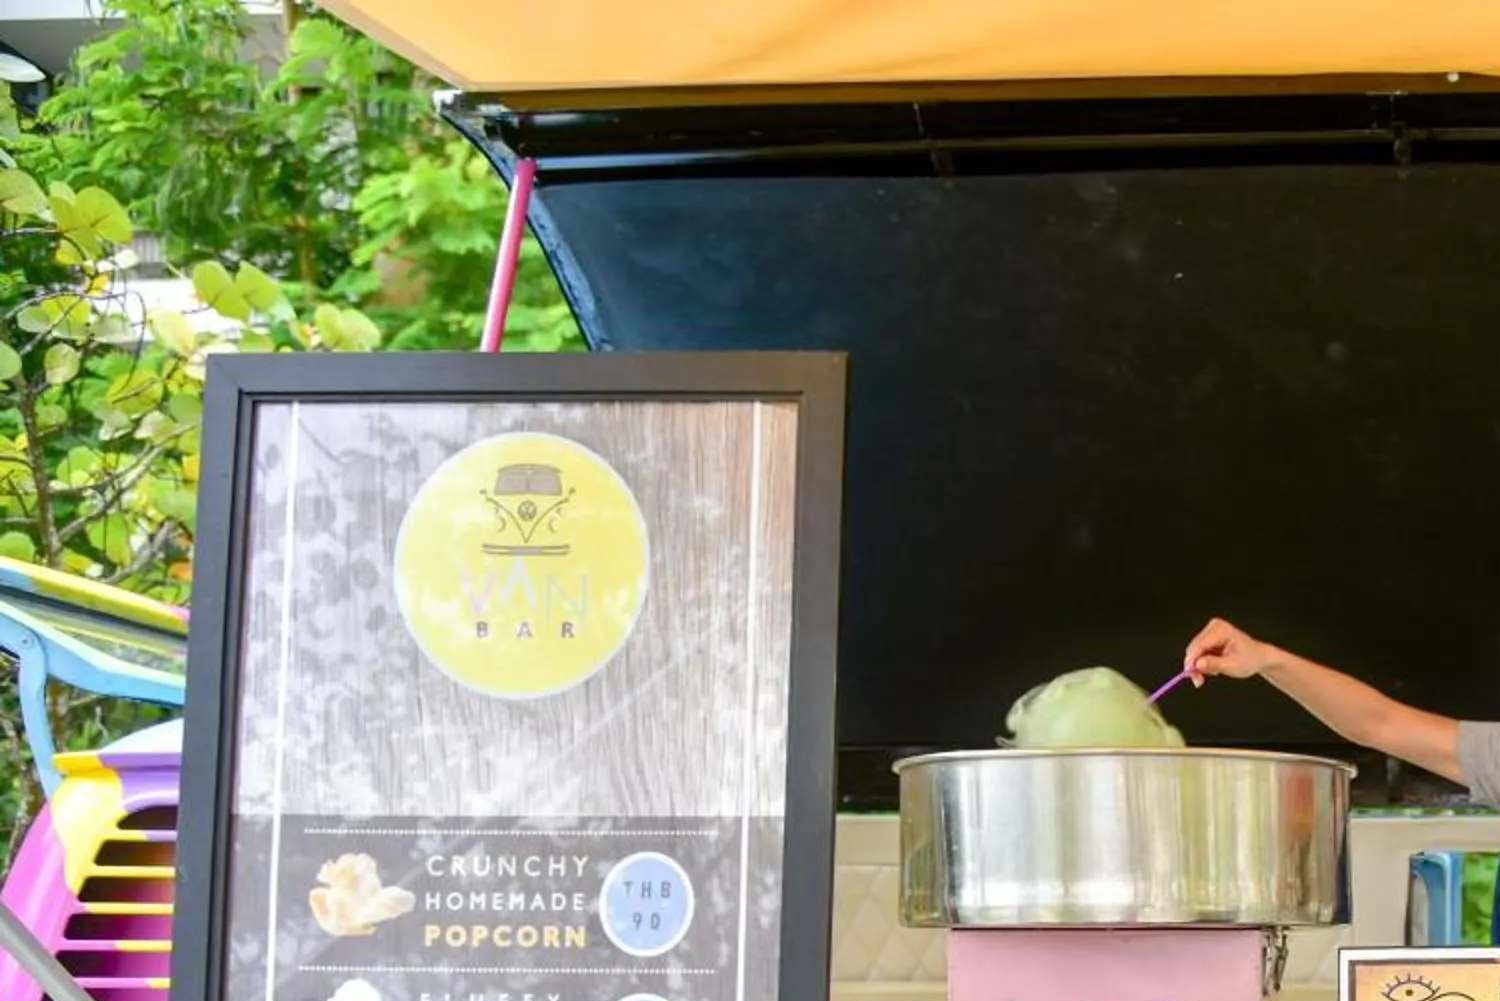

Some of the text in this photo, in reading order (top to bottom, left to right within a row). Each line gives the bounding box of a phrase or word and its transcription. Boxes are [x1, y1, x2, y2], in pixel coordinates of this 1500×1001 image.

[461, 557, 589, 622] VAN
[476, 621, 575, 639] BAR
[425, 855, 588, 878] CRUNCHY
[623, 881, 672, 899] THB
[425, 892, 586, 911] HOMEMADE
[632, 912, 662, 930] 90
[424, 925, 587, 947] POPCORN
